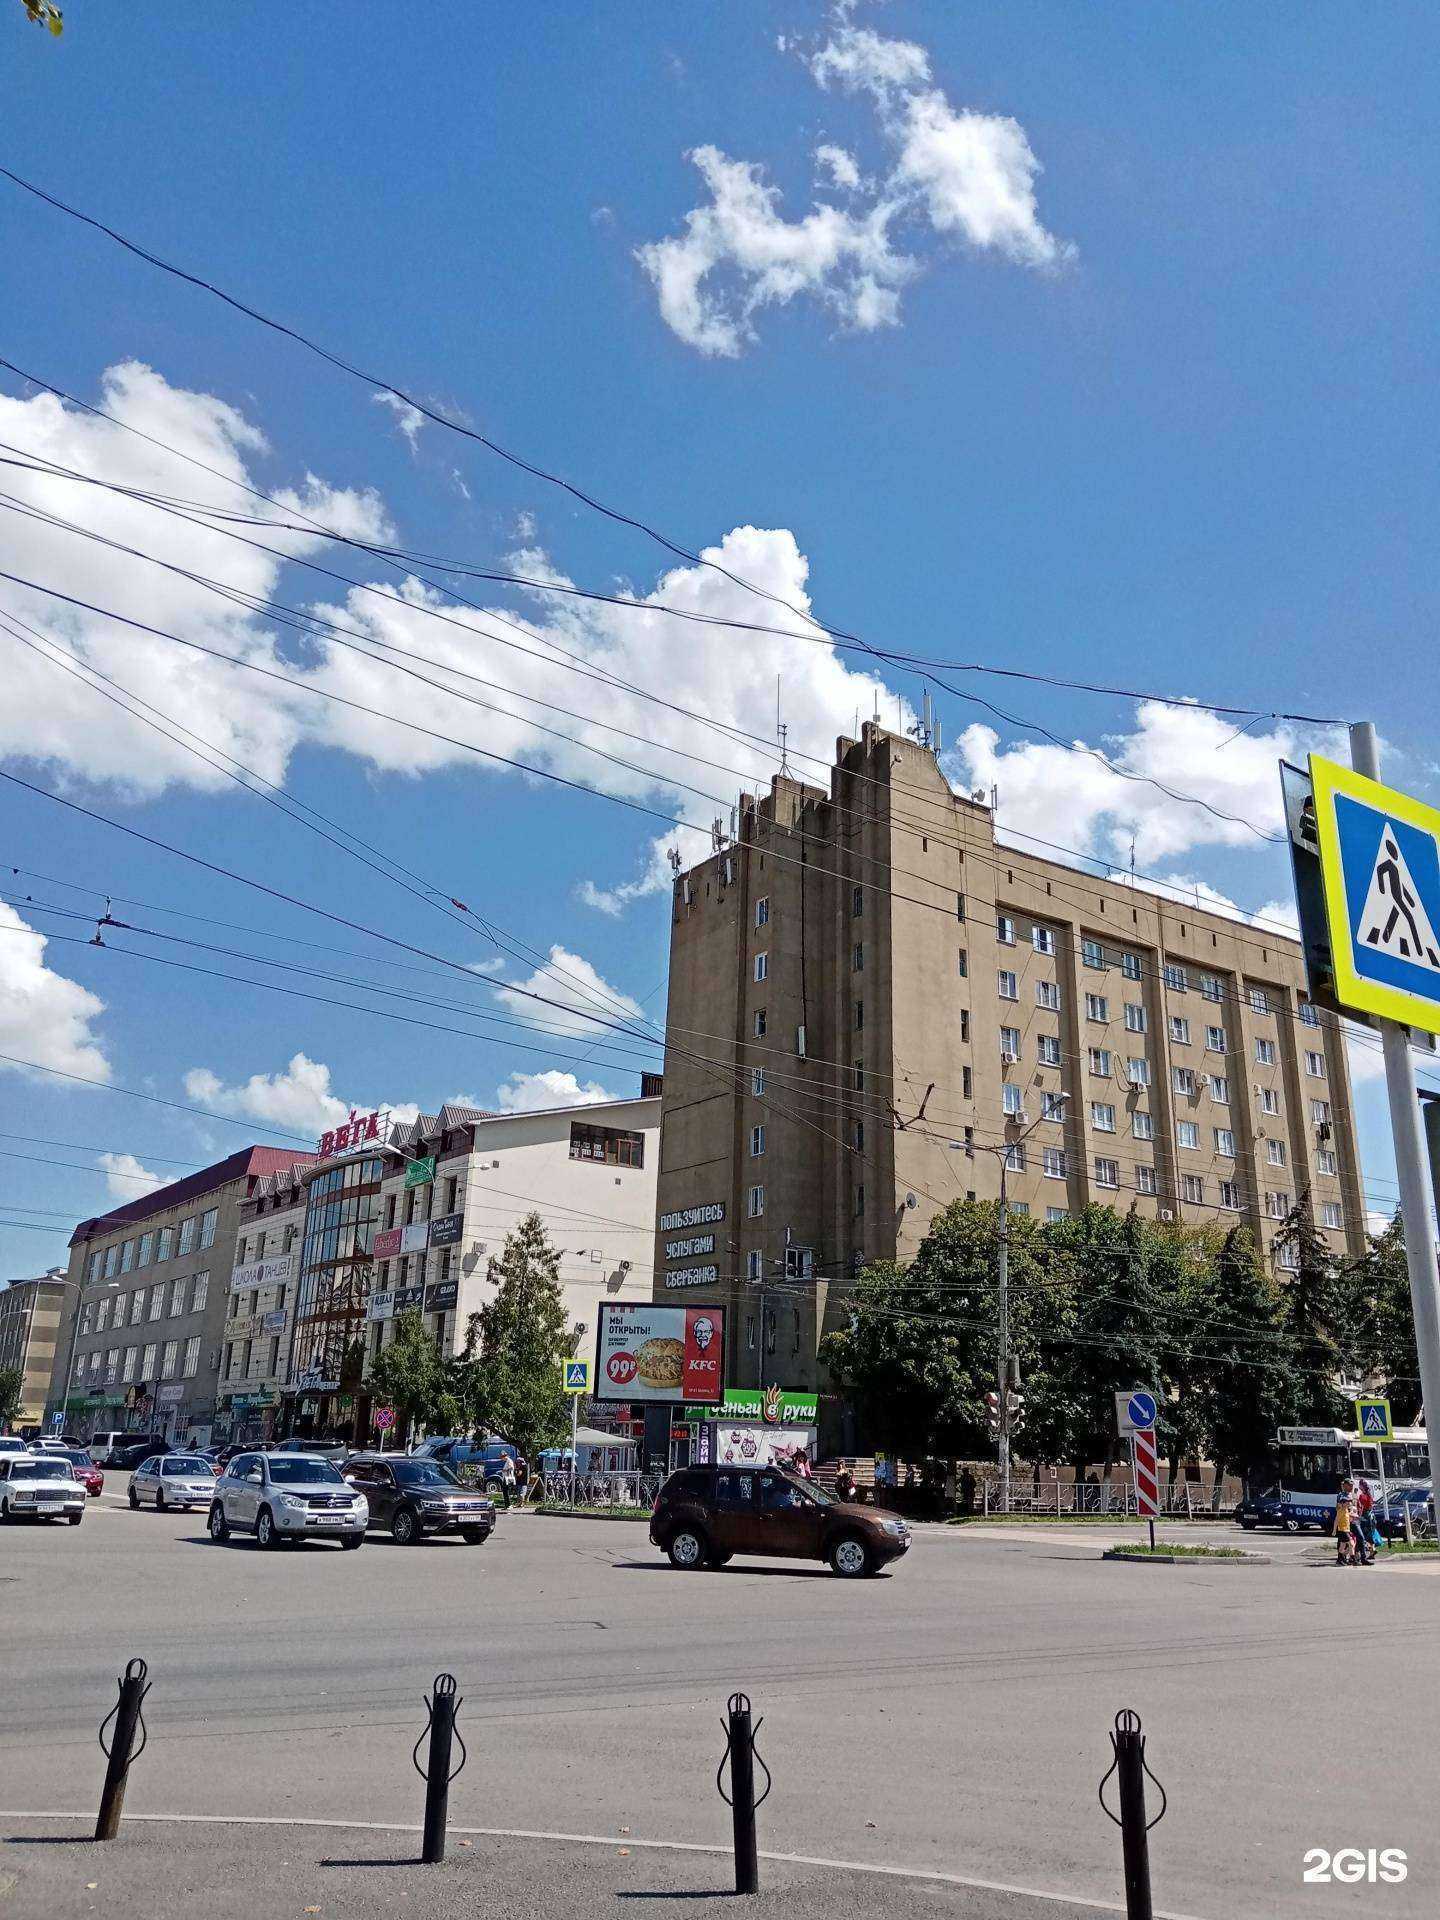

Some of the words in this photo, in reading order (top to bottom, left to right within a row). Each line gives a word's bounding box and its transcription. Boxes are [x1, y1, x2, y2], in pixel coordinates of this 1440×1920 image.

[319, 1112, 379, 1157] ВЕГА
[609, 1317, 623, 1325] МЫ
[608, 1325, 651, 1335] ОТКРЫТЫ!
[689, 1359, 716, 1371] KFC
[783, 1404, 816, 1420] руки
[1281, 1491, 1292, 1503] 60
